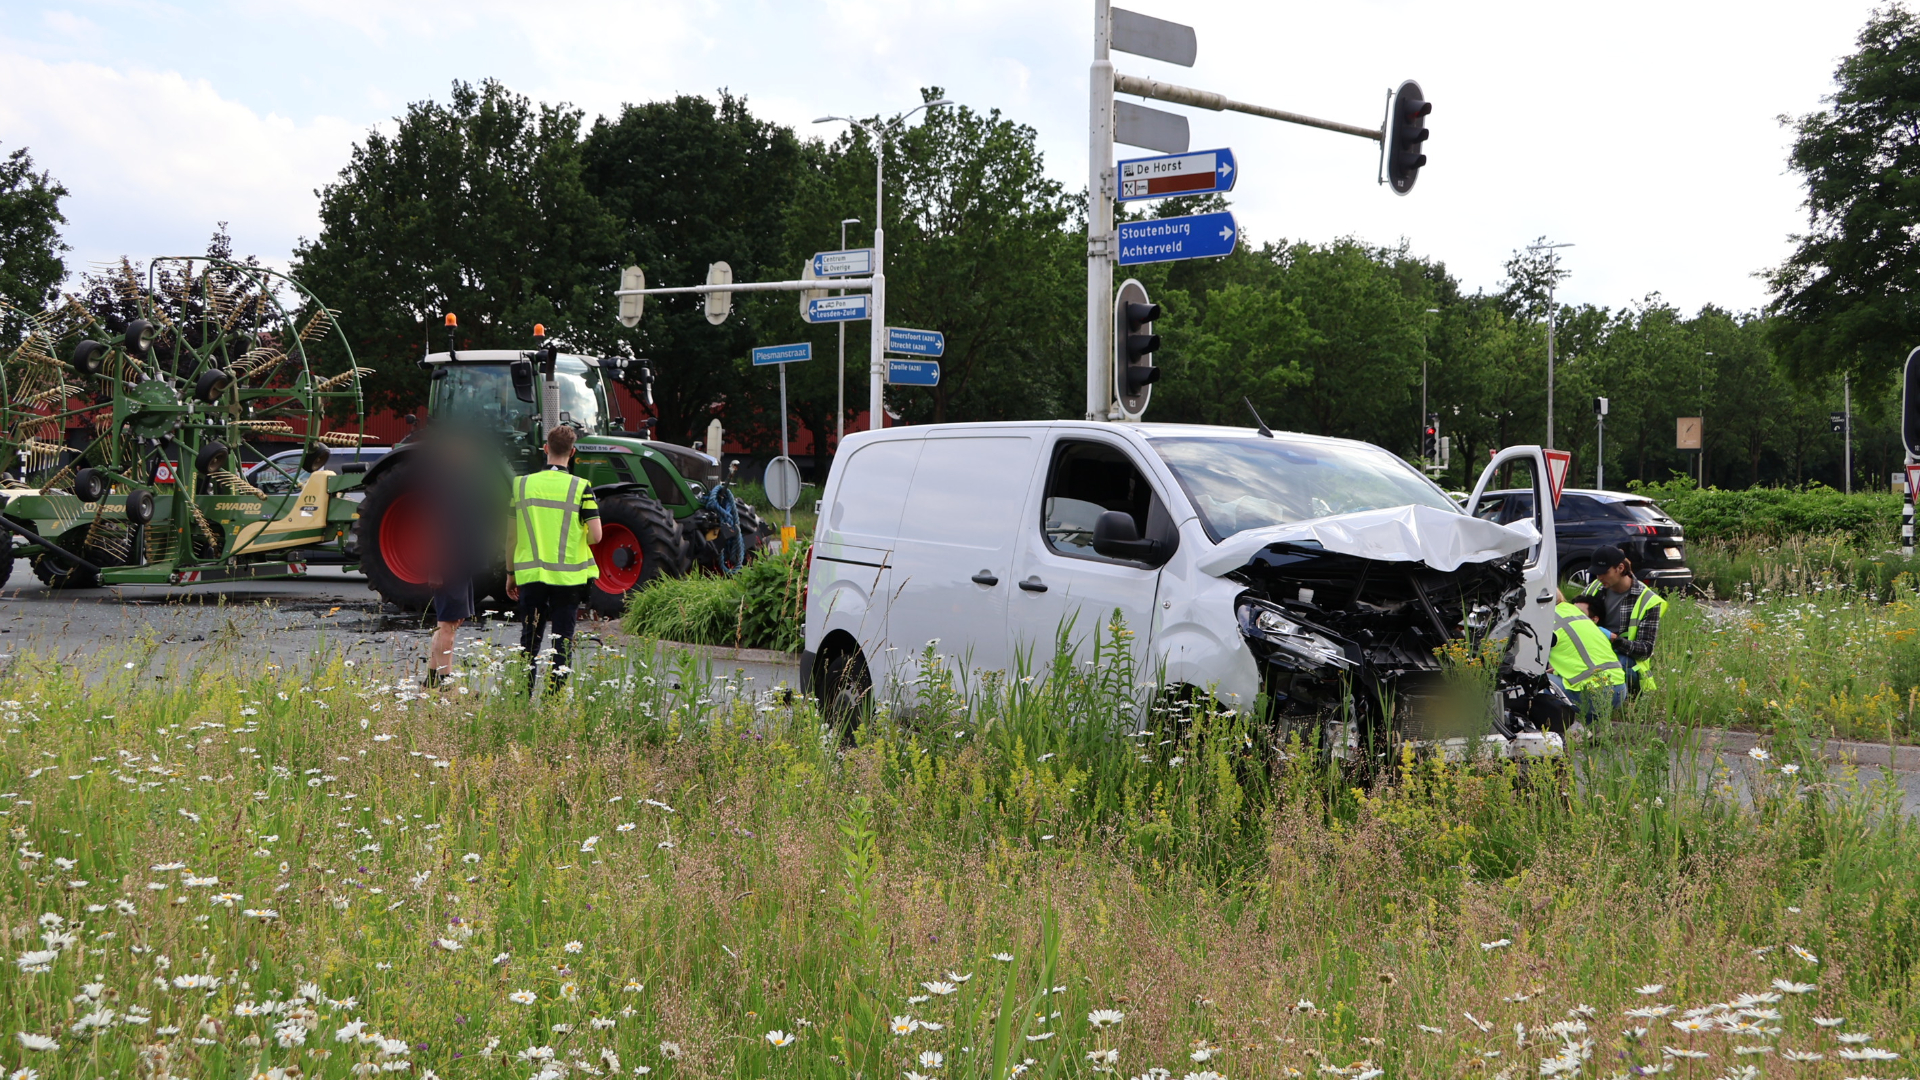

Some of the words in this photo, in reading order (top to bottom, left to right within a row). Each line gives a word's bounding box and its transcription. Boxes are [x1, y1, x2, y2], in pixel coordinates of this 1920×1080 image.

[1137, 164, 1150, 175] De
[1154, 160, 1182, 173] Horst
[1121, 223, 1190, 239] Stoutenburg
[1122, 240, 1182, 258] Achterveld
[830, 264, 851, 272] Overige
[816, 308, 856, 318] Leusden-Zuid
[891, 331, 922, 341] Amersfoort
[890, 341, 912, 349] Utrecht
[756, 348, 806, 360] Plesmanstraat
[890, 362, 908, 371] Zwolle
[214, 502, 262, 511] SWADRO
